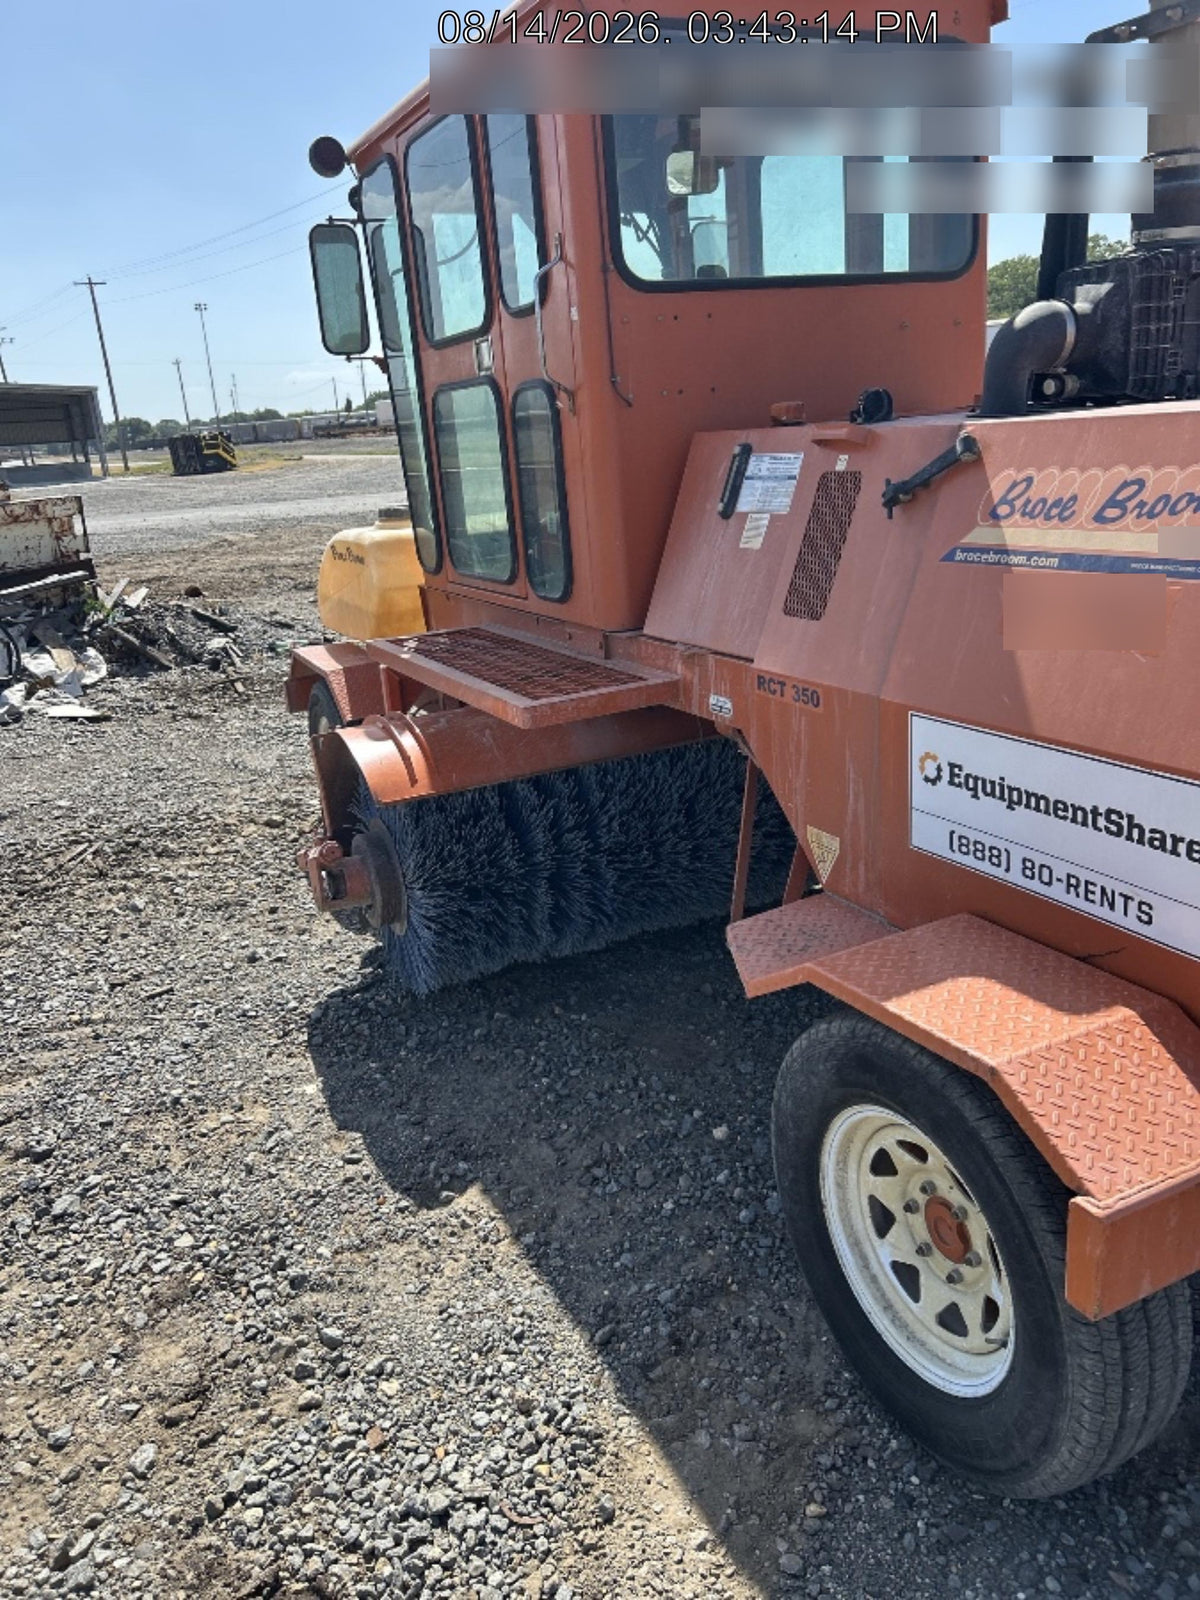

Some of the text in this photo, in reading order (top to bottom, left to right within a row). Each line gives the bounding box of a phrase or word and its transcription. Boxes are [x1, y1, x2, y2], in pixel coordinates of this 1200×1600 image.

[988, 475, 1200, 525] Broce Broo
[955, 549, 1059, 568] brocebroom.com
[757, 674, 820, 708] RCT 350
[947, 761, 1200, 864] EquipmentShare
[949, 830, 1154, 926] (888) 80-RENTS
